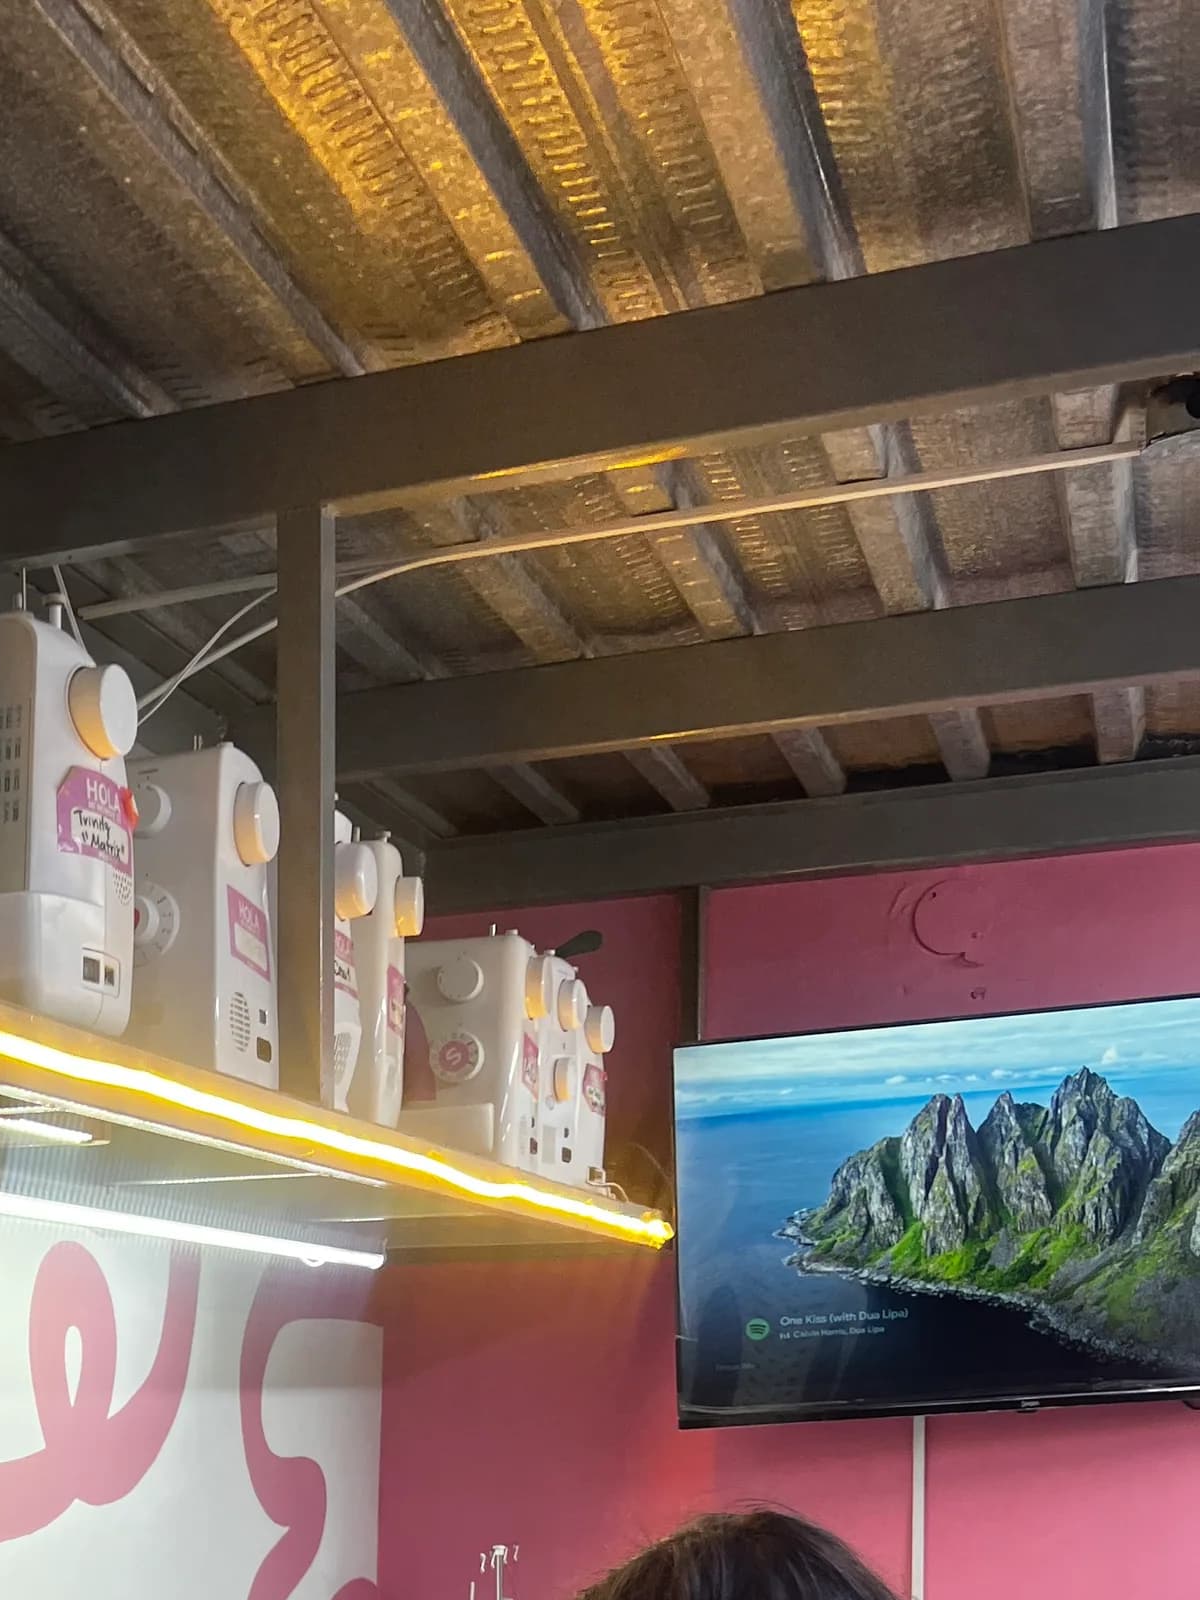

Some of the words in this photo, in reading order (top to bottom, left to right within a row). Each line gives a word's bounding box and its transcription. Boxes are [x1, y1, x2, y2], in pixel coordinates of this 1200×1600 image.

[86, 777, 121, 811] HOLA
[779, 1316, 803, 1327] One
[805, 1314, 828, 1325] Kiss
[829, 1311, 857, 1324] (with
[858, 1311, 880, 1321] Dua
[882, 1308, 909, 1321] Lipa)
